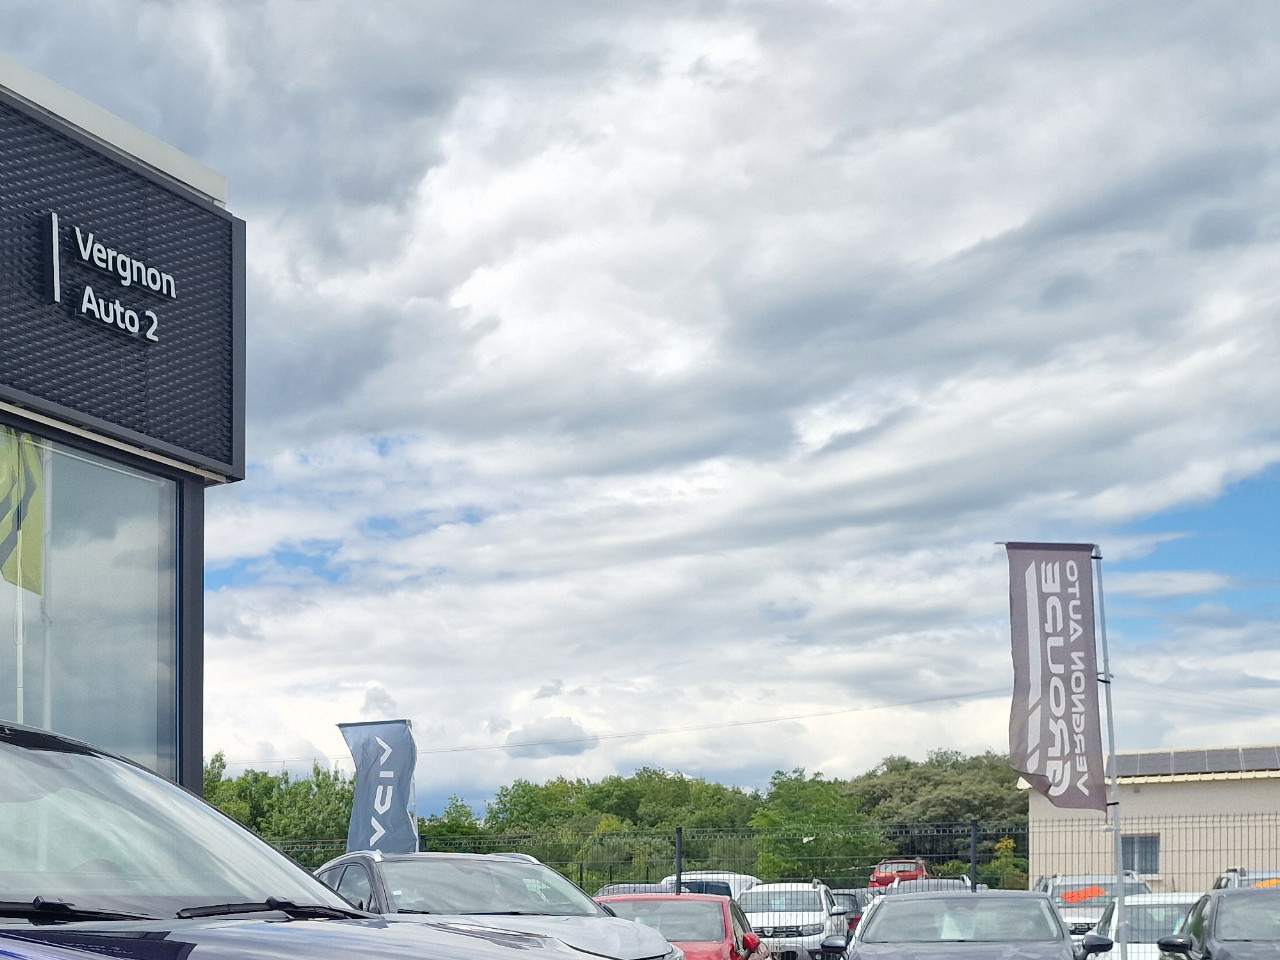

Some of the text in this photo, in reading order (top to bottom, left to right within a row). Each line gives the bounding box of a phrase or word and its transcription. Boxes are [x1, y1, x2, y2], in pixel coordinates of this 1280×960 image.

[75, 226, 176, 298] Vergnon
[82, 286, 159, 342] Auto 2
